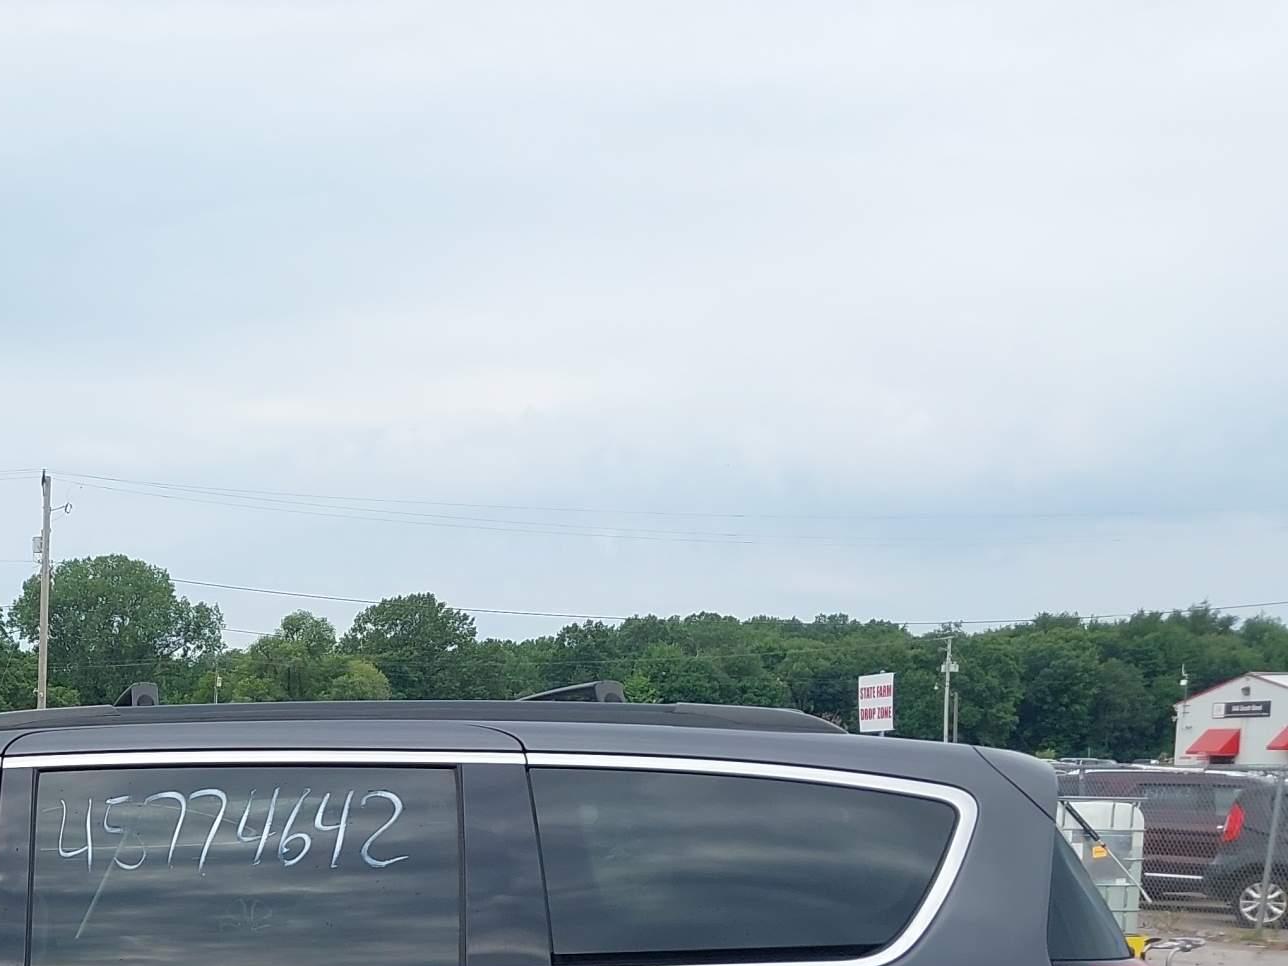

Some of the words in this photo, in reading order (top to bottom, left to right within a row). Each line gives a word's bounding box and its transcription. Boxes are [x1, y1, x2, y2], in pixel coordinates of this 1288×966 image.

[860, 686, 876, 700] STATE
[877, 684, 892, 698] FARM
[860, 707, 876, 721] DROP
[877, 706, 892, 719] ZONE
[58, 787, 410, 873] 45774642
